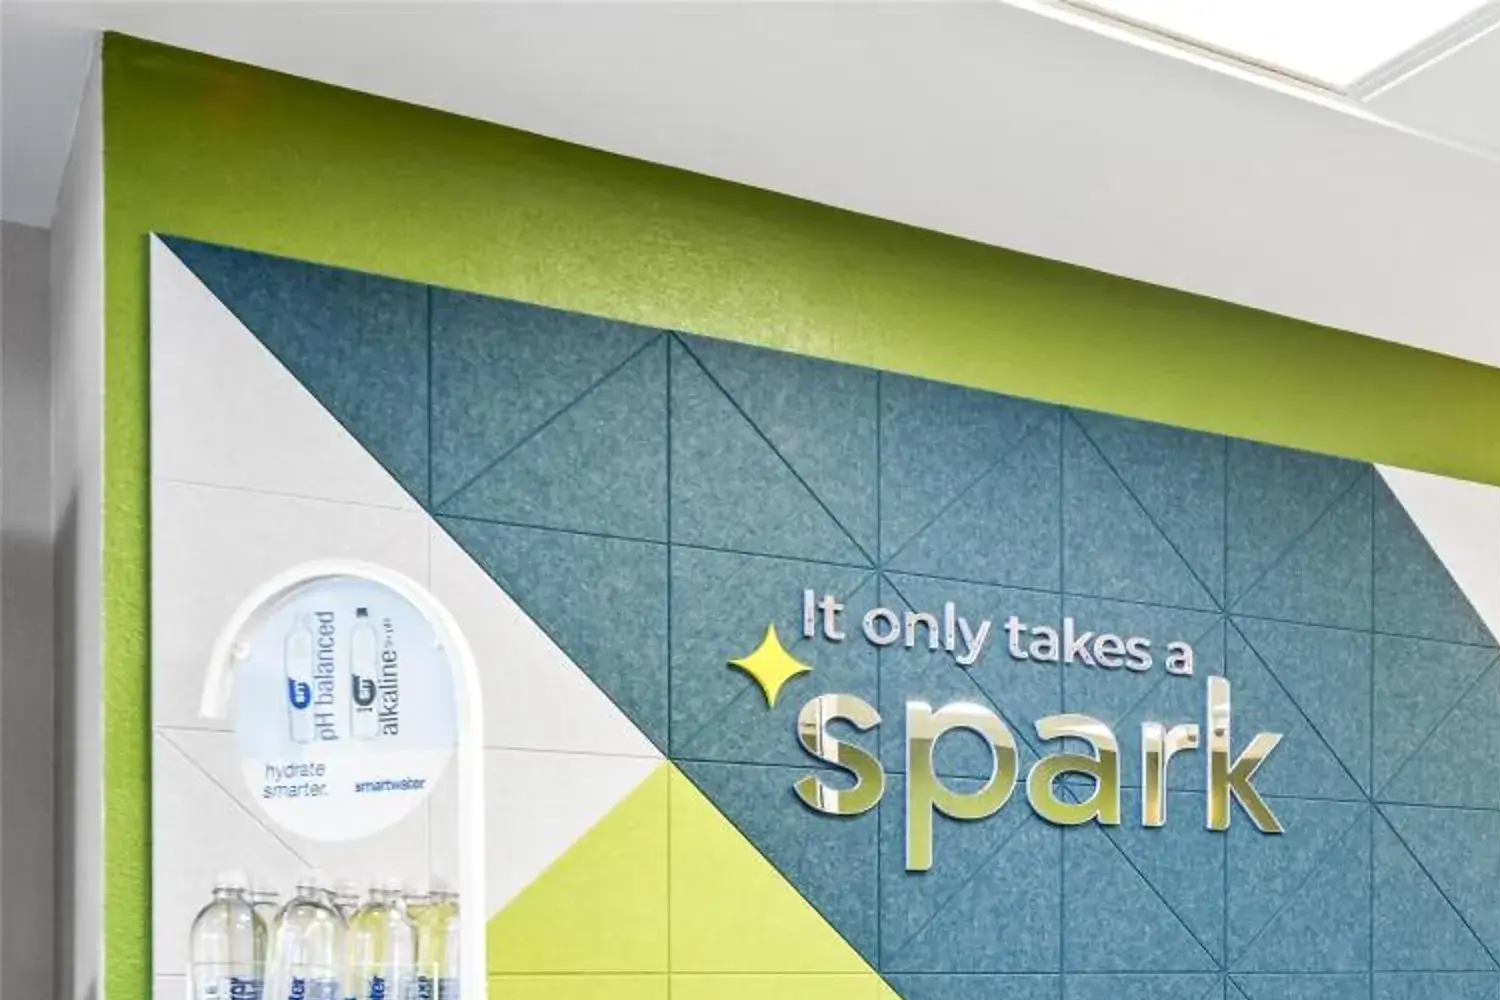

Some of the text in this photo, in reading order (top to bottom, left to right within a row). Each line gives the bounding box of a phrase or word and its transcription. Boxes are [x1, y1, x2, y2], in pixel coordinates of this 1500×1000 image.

[314, 610, 338, 741] pH balanced
[803, 588, 1194, 676] It only takes a
[378, 650, 399, 736] alkaline
[264, 761, 327, 782] hydrate
[354, 776, 427, 793] smartwater
[793, 675, 1285, 872] spark
